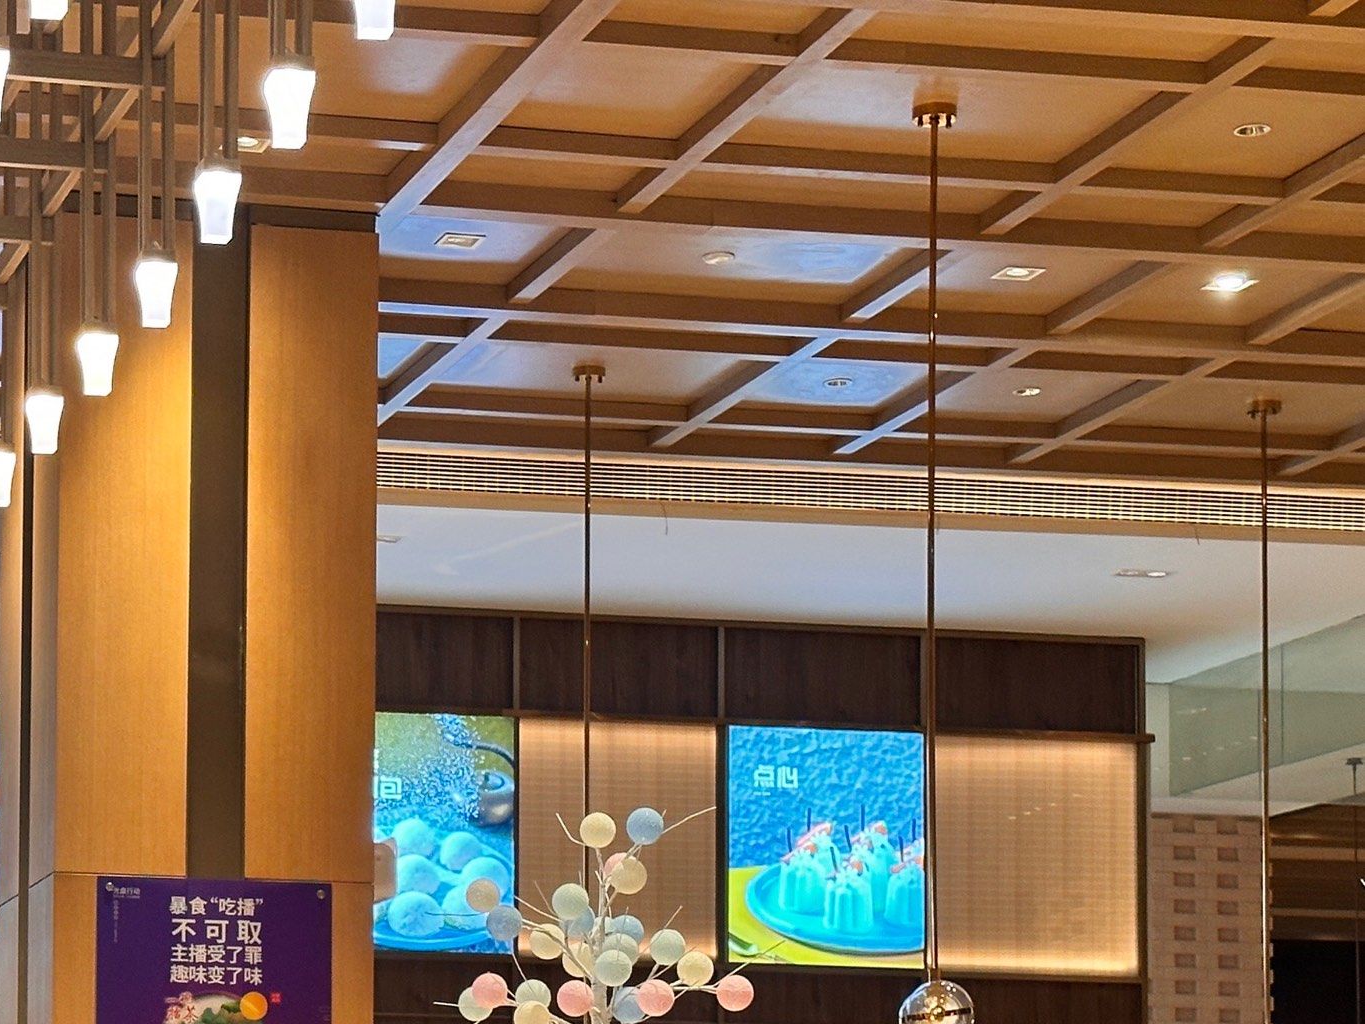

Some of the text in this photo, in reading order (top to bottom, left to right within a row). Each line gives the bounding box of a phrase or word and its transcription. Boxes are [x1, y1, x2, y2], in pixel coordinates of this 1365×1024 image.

[374, 774, 402, 801] 包
[753, 764, 799, 789] 点心
[171, 918, 263, 945] 不可取
[169, 943, 264, 965] 主播受了罪
[169, 964, 264, 986] 趣味变了味
